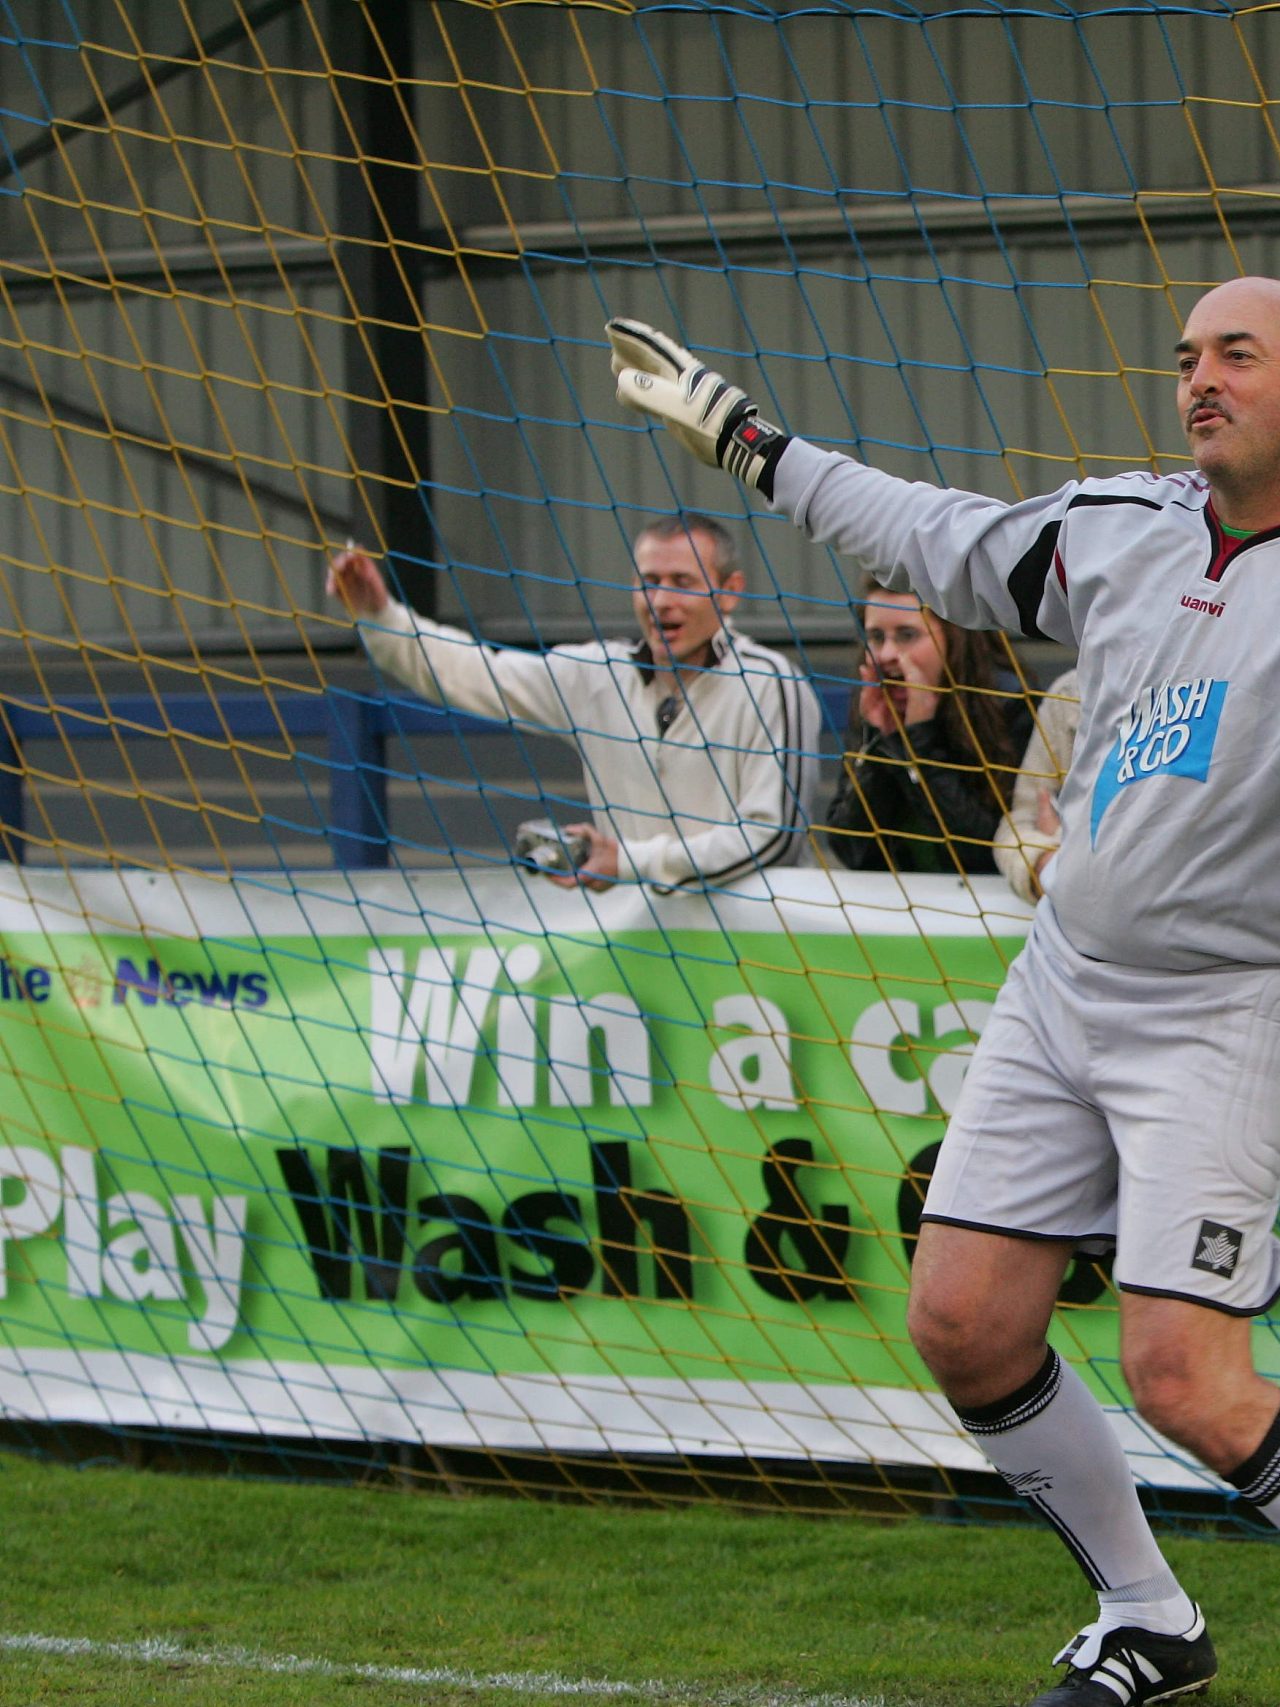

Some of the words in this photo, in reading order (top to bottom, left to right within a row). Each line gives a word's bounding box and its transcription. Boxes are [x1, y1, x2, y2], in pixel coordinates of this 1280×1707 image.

[1117, 677, 1214, 761] WASH
[0, 957, 51, 1002] he
[112, 956, 269, 1008] News
[368, 944, 652, 1106] Win
[708, 993, 798, 1112] a
[851, 997, 998, 1118] ca
[0, 1145, 248, 1351] Play
[274, 1142, 693, 1304] Wash
[744, 1137, 858, 1304] &
